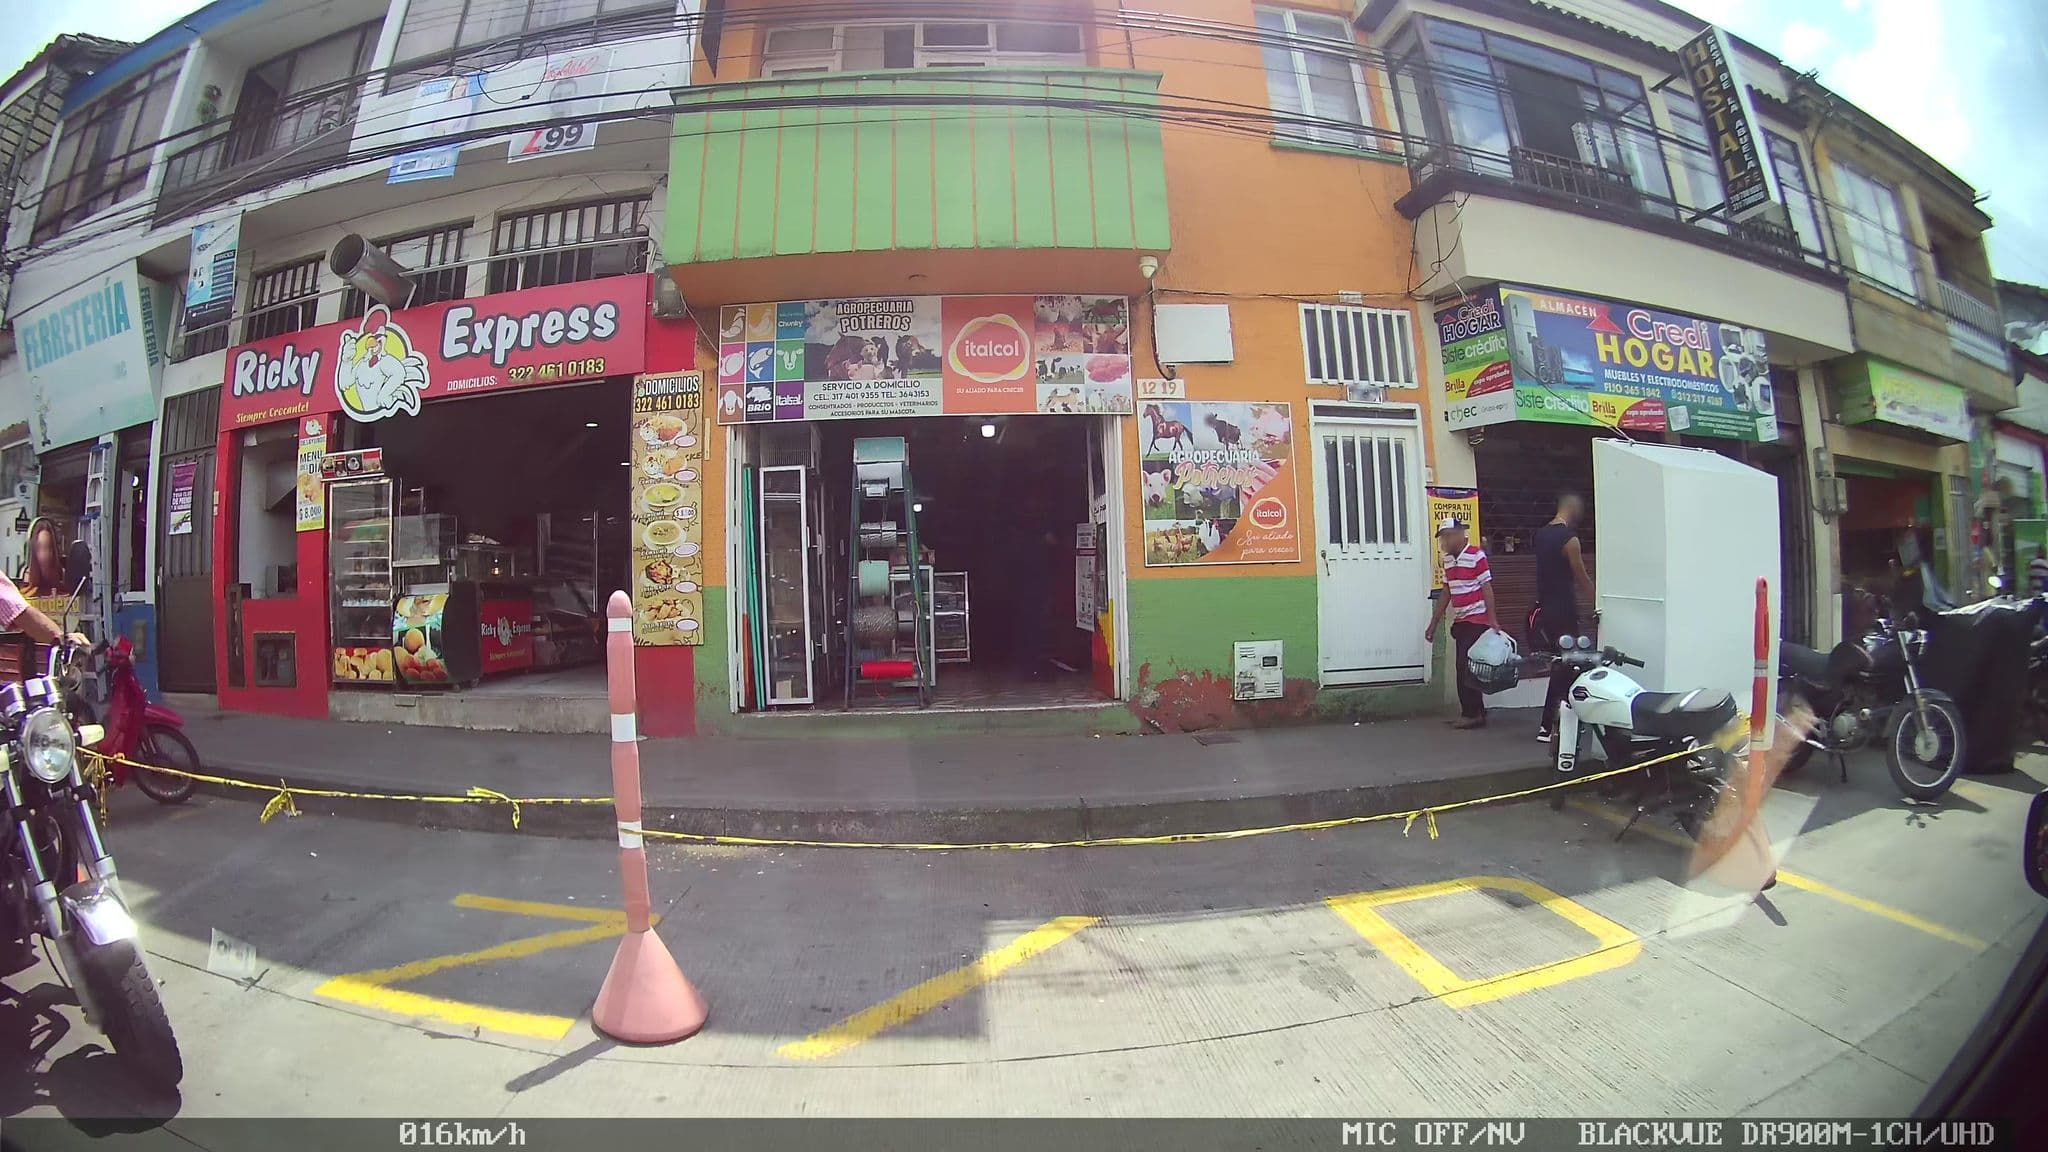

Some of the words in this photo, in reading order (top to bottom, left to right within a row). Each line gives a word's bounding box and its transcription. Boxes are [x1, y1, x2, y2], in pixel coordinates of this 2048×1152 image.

[1686, 40, 1745, 181] HOSTAL
[836, 300, 914, 315] AGROPECUARIA
[1457, 298, 1495, 321] Credi
[22, 277, 131, 373] FERRETERÍA
[840, 314, 911, 331] POTREROS
[1443, 311, 1501, 343] HOGAR
[1627, 309, 1712, 351] Credi
[233, 345, 320, 396] Ricky
[443, 303, 616, 365] Express
[965, 340, 1019, 357] italcol
[1595, 332, 1717, 379] HOGAR
[447, 375, 498, 391] DOMICILIOS:
[508, 366, 535, 382] 322
[539, 361, 563, 378] 461
[567, 357, 605, 377] 0183
[1604, 369, 1640, 383] MUEBLES
[1640, 373, 1647, 384] Y
[645, 376, 699, 396] DOMICILIOS
[822, 382, 862, 391] SERVICIO
[874, 380, 920, 389] DOMICILIO
[1142, 381, 1156, 394] 12
[1161, 381, 1177, 395] 19
[1445, 379, 1466, 392] Brilla
[1604, 382, 1623, 393] FIJO
[899, 390, 930, 398] 3643153
[635, 396, 652, 412] 322
[655, 395, 672, 411] 461
[675, 393, 699, 409] 0183
[1592, 400, 1616, 414] Brilla
[236, 409, 267, 424] Siempre
[1168, 450, 1260, 465] AGROPECUARIA
[1173, 460, 1258, 490] Potreros
[1256, 508, 1282, 518] italcol
[1433, 503, 1461, 511] COMPRA
[1463, 503, 1472, 511] TU
[1434, 511, 1449, 521] KIT
[1262, 530, 1294, 540] aliado
[1240, 547, 1265, 560] para
